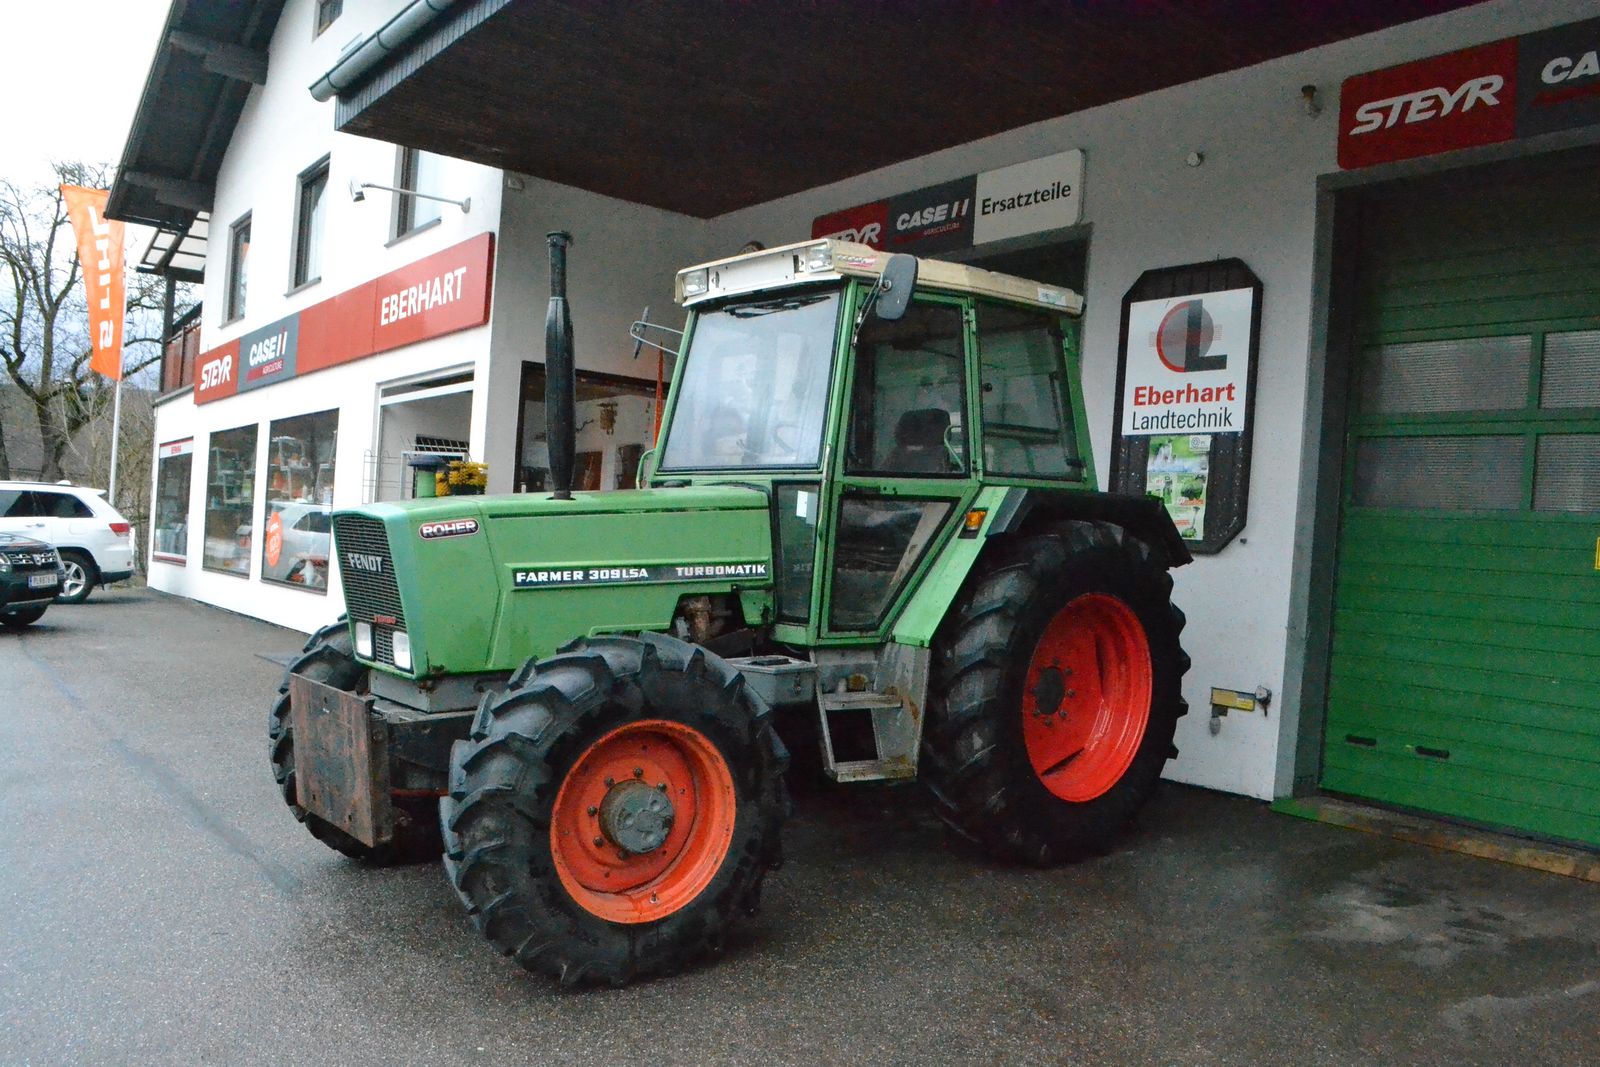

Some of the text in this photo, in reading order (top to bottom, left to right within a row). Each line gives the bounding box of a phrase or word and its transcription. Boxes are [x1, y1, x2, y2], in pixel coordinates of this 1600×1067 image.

[1348, 74, 1504, 136] STEYR
[981, 181, 1071, 216] Ersatzteile
[896, 203, 949, 231] CASE
[821, 222, 881, 244] EYR
[380, 266, 467, 326] EBERHART
[249, 335, 277, 367] CASE
[199, 354, 232, 391] STEYR
[1133, 382, 1236, 406] Eberhart
[1132, 407, 1233, 430] Landtechnik
[422, 521, 477, 537] ROHER
[347, 552, 383, 573] FENDT
[516, 570, 584, 583] FARMER
[675, 564, 766, 577] TURBOMATIK
